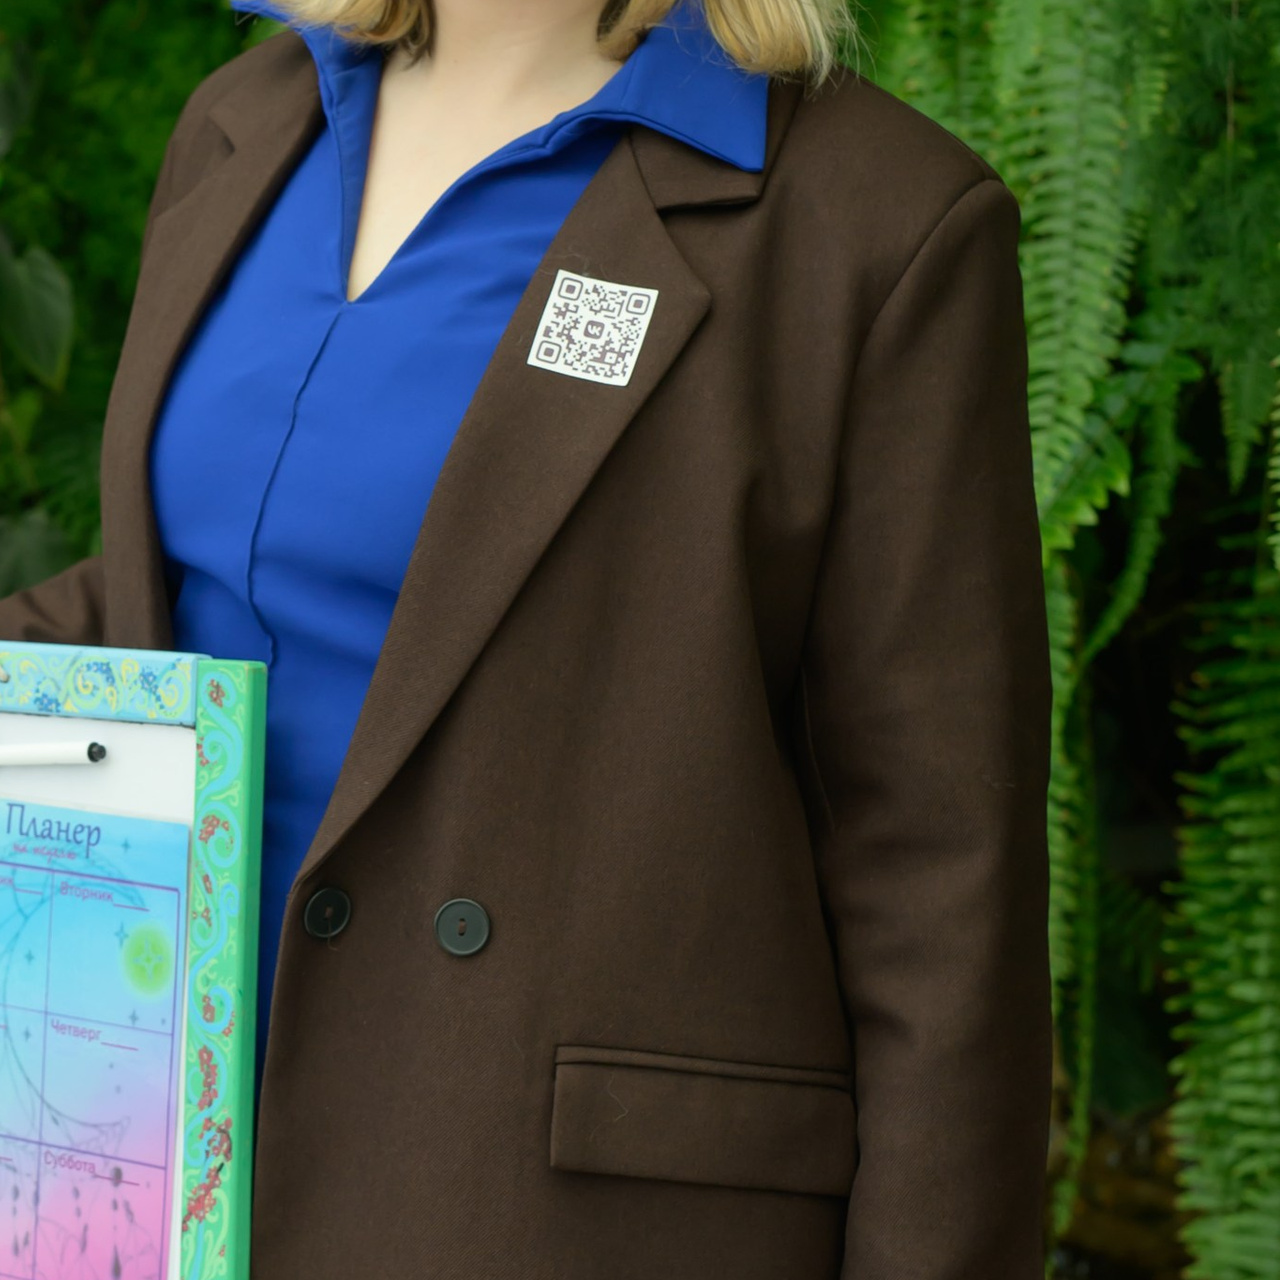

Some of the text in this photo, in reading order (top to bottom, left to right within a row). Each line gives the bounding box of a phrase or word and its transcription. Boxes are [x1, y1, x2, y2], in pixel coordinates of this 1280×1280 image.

[7, 803, 101, 858] Планер
[60, 882, 113, 903] Вторник
[51, 1019, 103, 1041] Четверг
[45, 1151, 96, 1175] Суббота
